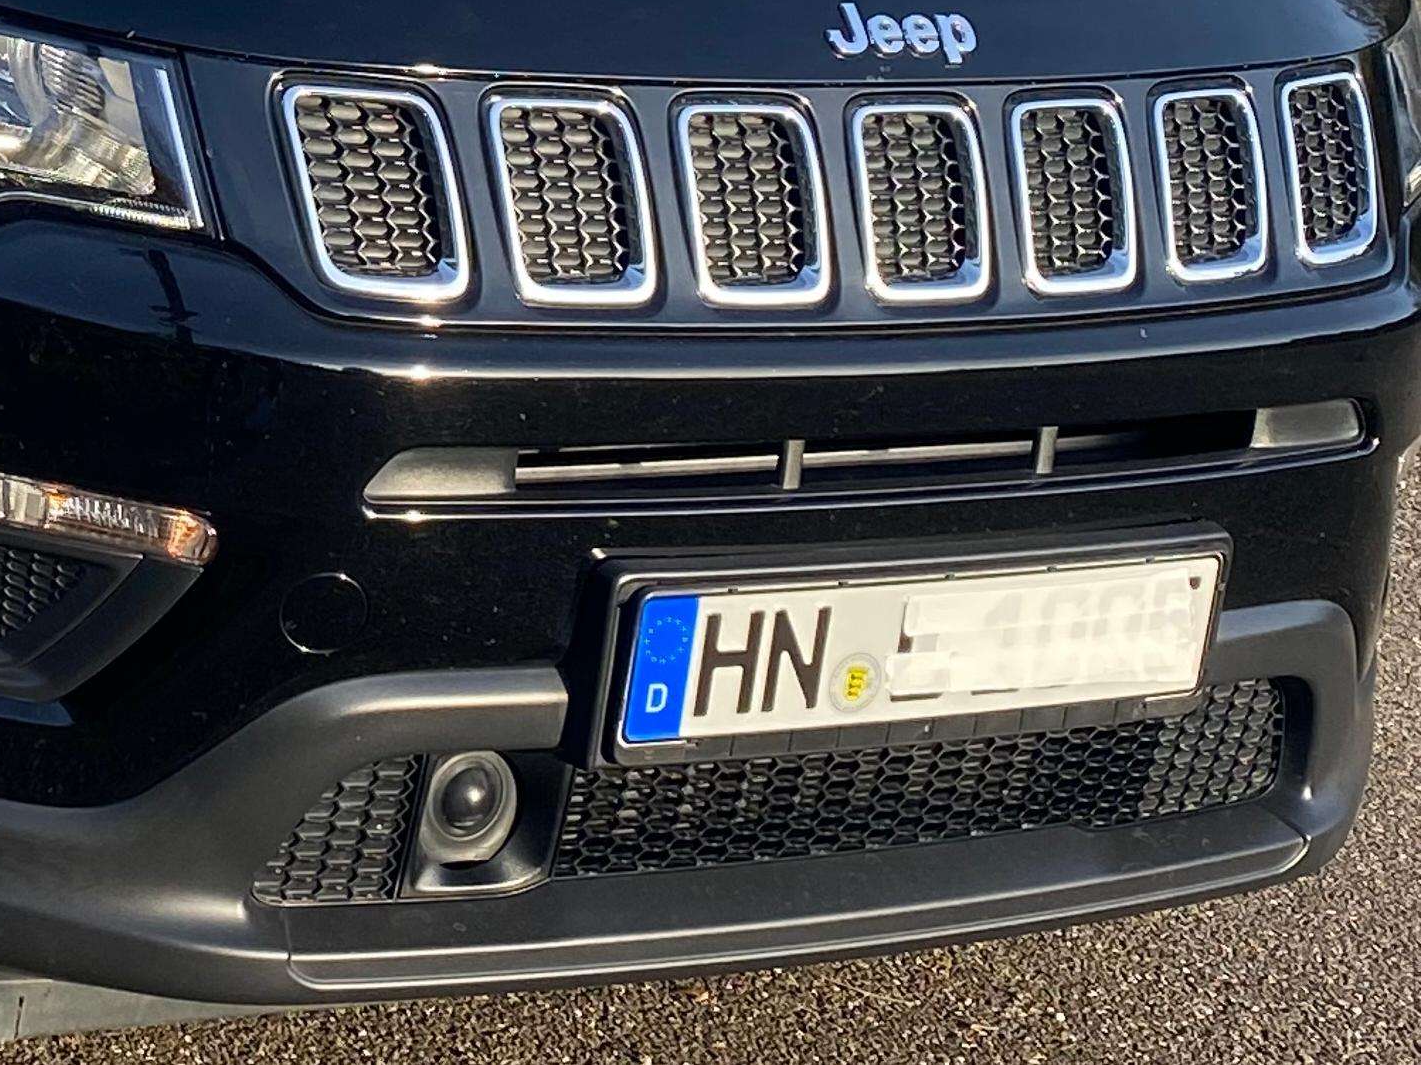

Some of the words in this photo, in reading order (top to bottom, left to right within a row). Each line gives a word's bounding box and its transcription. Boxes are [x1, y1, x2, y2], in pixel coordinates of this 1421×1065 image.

[824, 2, 978, 66] Jeep
[693, 606, 832, 717] HN
[645, 682, 668, 713] D
